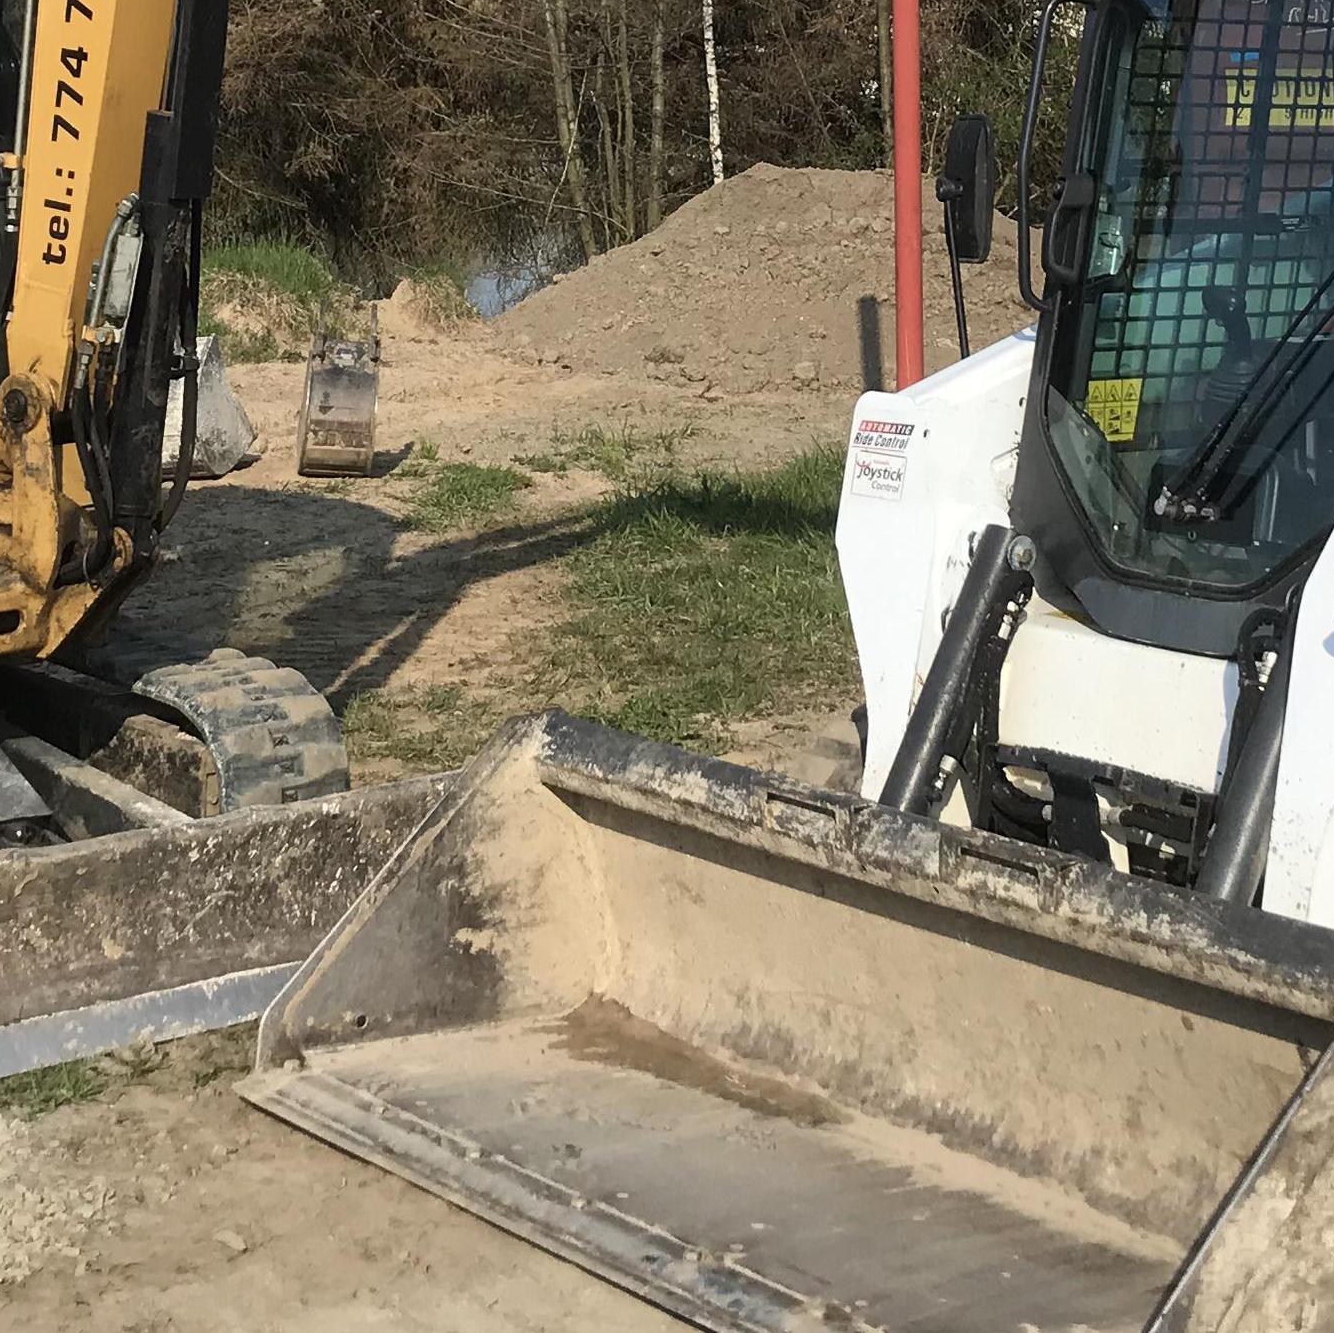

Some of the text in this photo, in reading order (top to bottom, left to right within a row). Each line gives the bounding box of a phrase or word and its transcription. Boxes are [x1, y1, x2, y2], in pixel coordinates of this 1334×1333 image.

[51, 46, 89, 143] 774
[41, 168, 75, 265] tel.:
[860, 420, 913, 435] AUTOMATIC
[853, 432, 909, 450] Ride Control
[871, 480, 900, 493] Control
